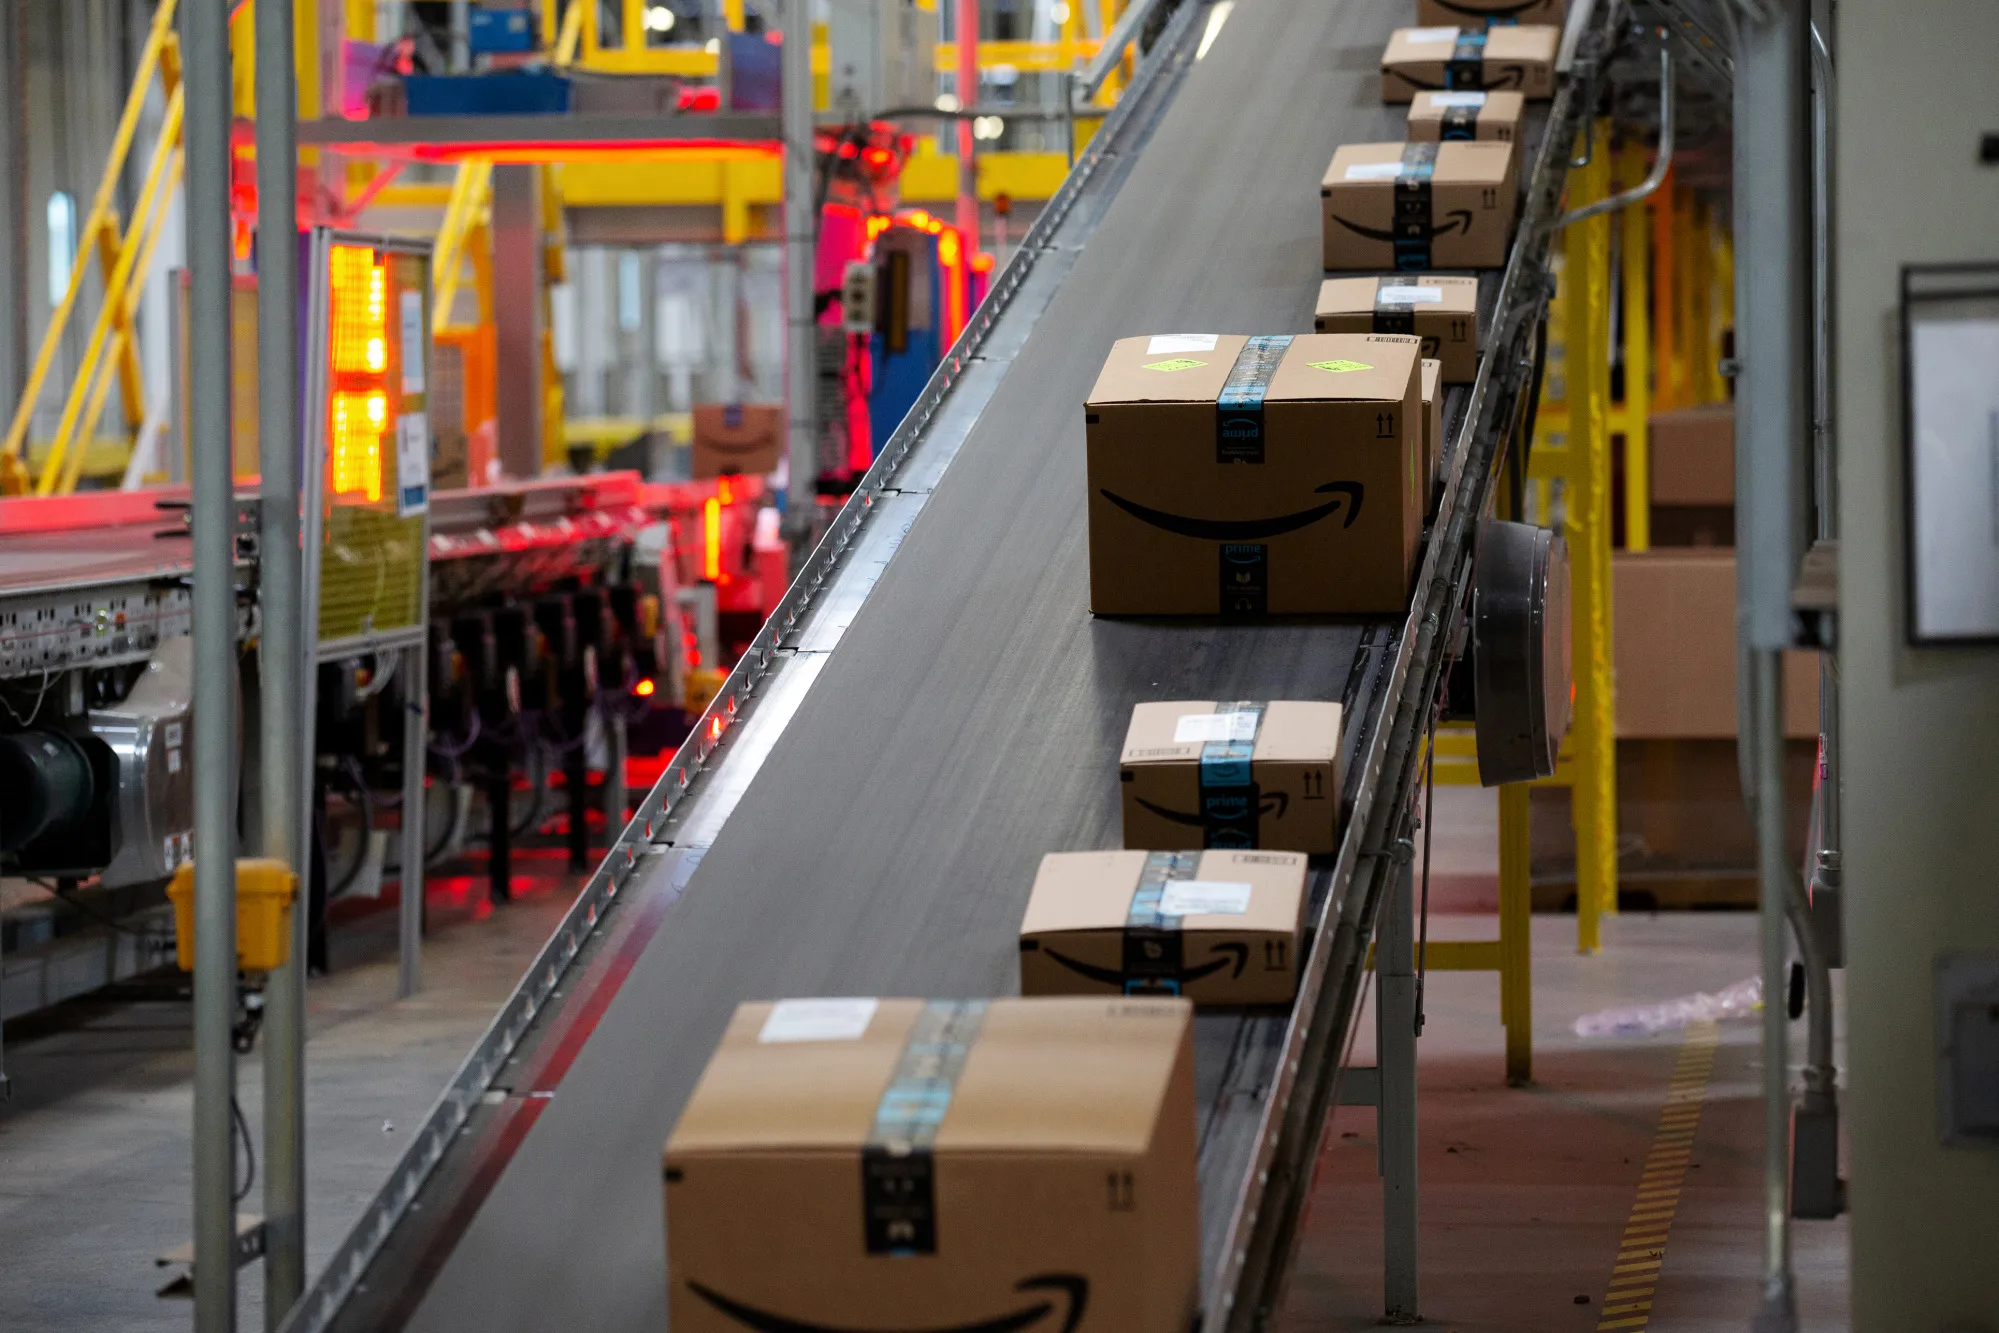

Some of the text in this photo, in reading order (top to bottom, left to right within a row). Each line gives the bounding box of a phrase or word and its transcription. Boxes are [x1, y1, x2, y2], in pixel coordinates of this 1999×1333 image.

[1222, 427, 1259, 441] prime
[1225, 543, 1262, 555] prime
[1205, 794, 1247, 808] prime
